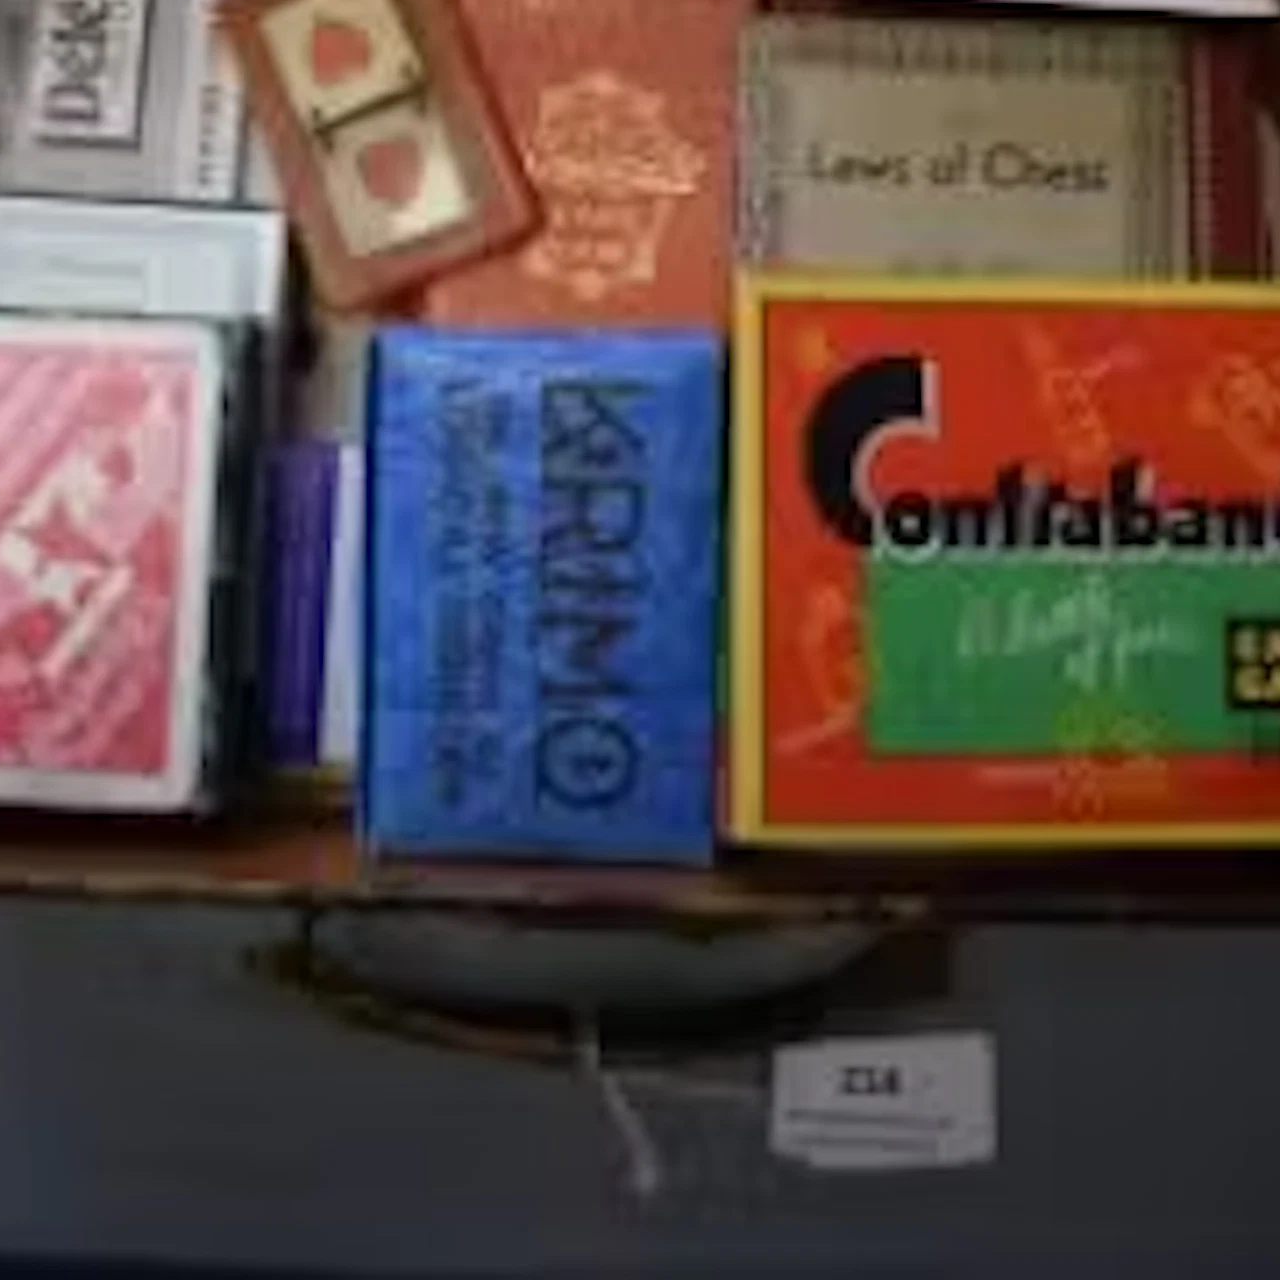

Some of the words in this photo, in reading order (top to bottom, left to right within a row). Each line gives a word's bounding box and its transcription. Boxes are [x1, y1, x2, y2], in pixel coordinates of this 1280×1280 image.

[808, 141, 910, 185] Laws
[929, 142, 968, 185] of
[983, 140, 1110, 193] Chess
[535, 382, 648, 812] KRIMO
